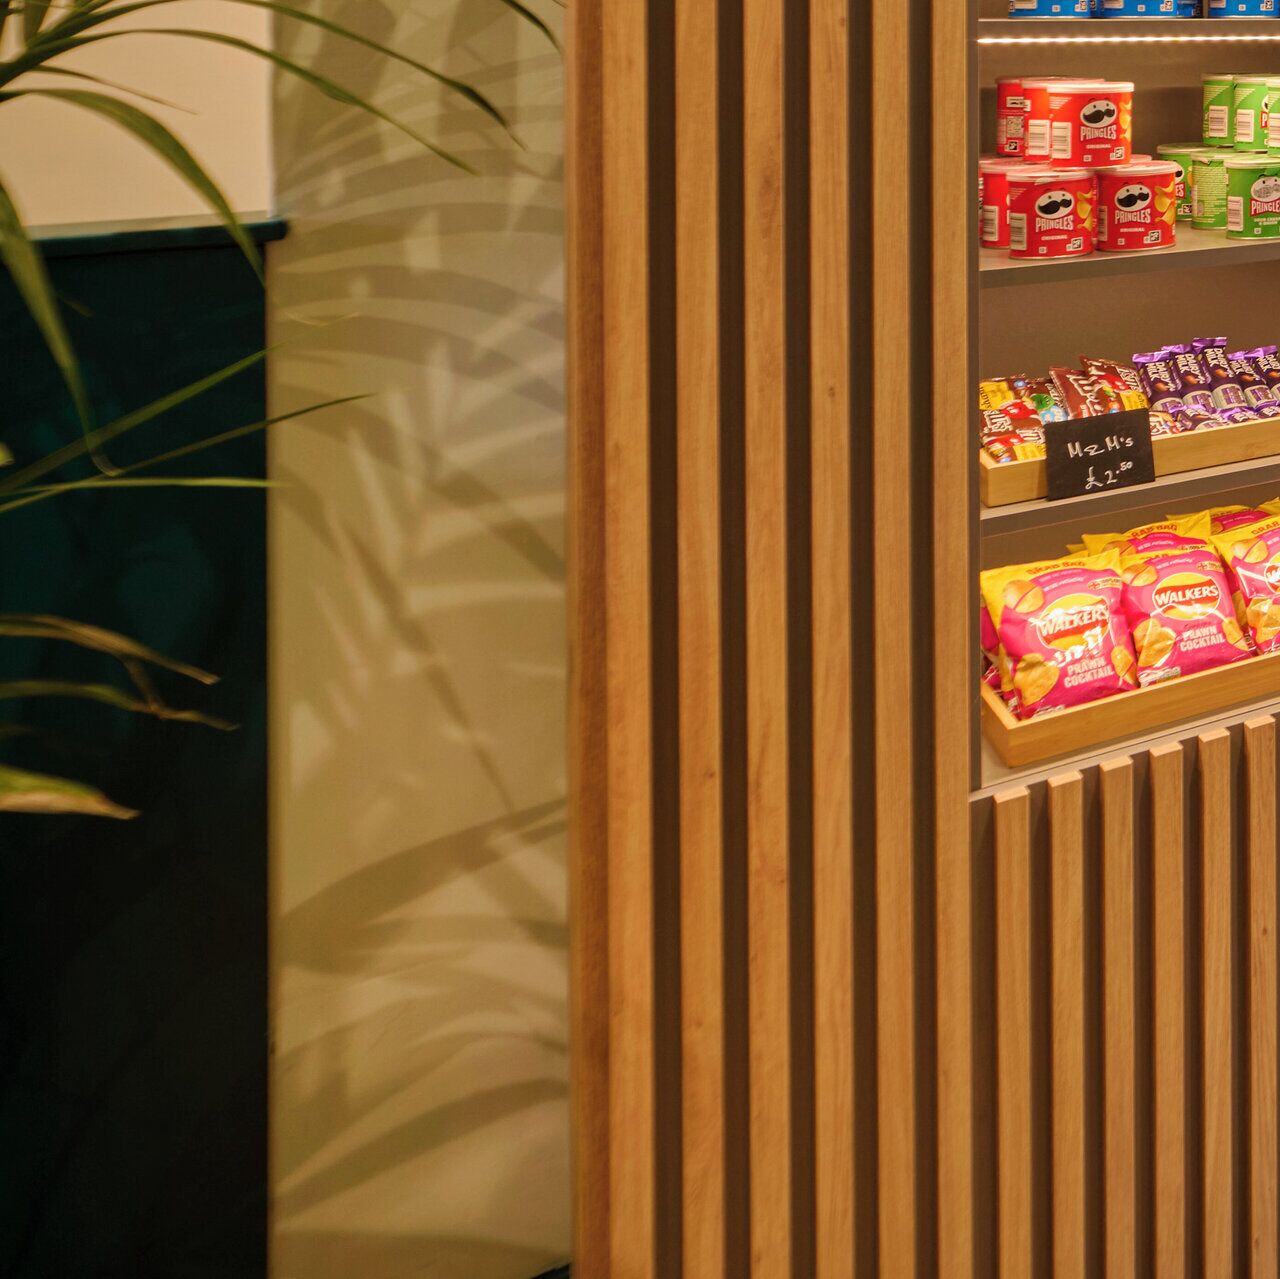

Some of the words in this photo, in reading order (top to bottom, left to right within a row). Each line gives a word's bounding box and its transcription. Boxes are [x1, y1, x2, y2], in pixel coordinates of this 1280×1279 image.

[1080, 124, 1117, 141] PRINGLES
[1035, 215, 1074, 232] PRINGLES
[1115, 208, 1151, 224] PRINGLES
[1155, 584, 1219, 606] WALKERS
[1039, 604, 1110, 637] WALKERS
[1182, 624, 1218, 641] PRAWN
[1180, 633, 1226, 653] COCKTAIL
[1064, 665, 1115, 689] COCKTAIL
